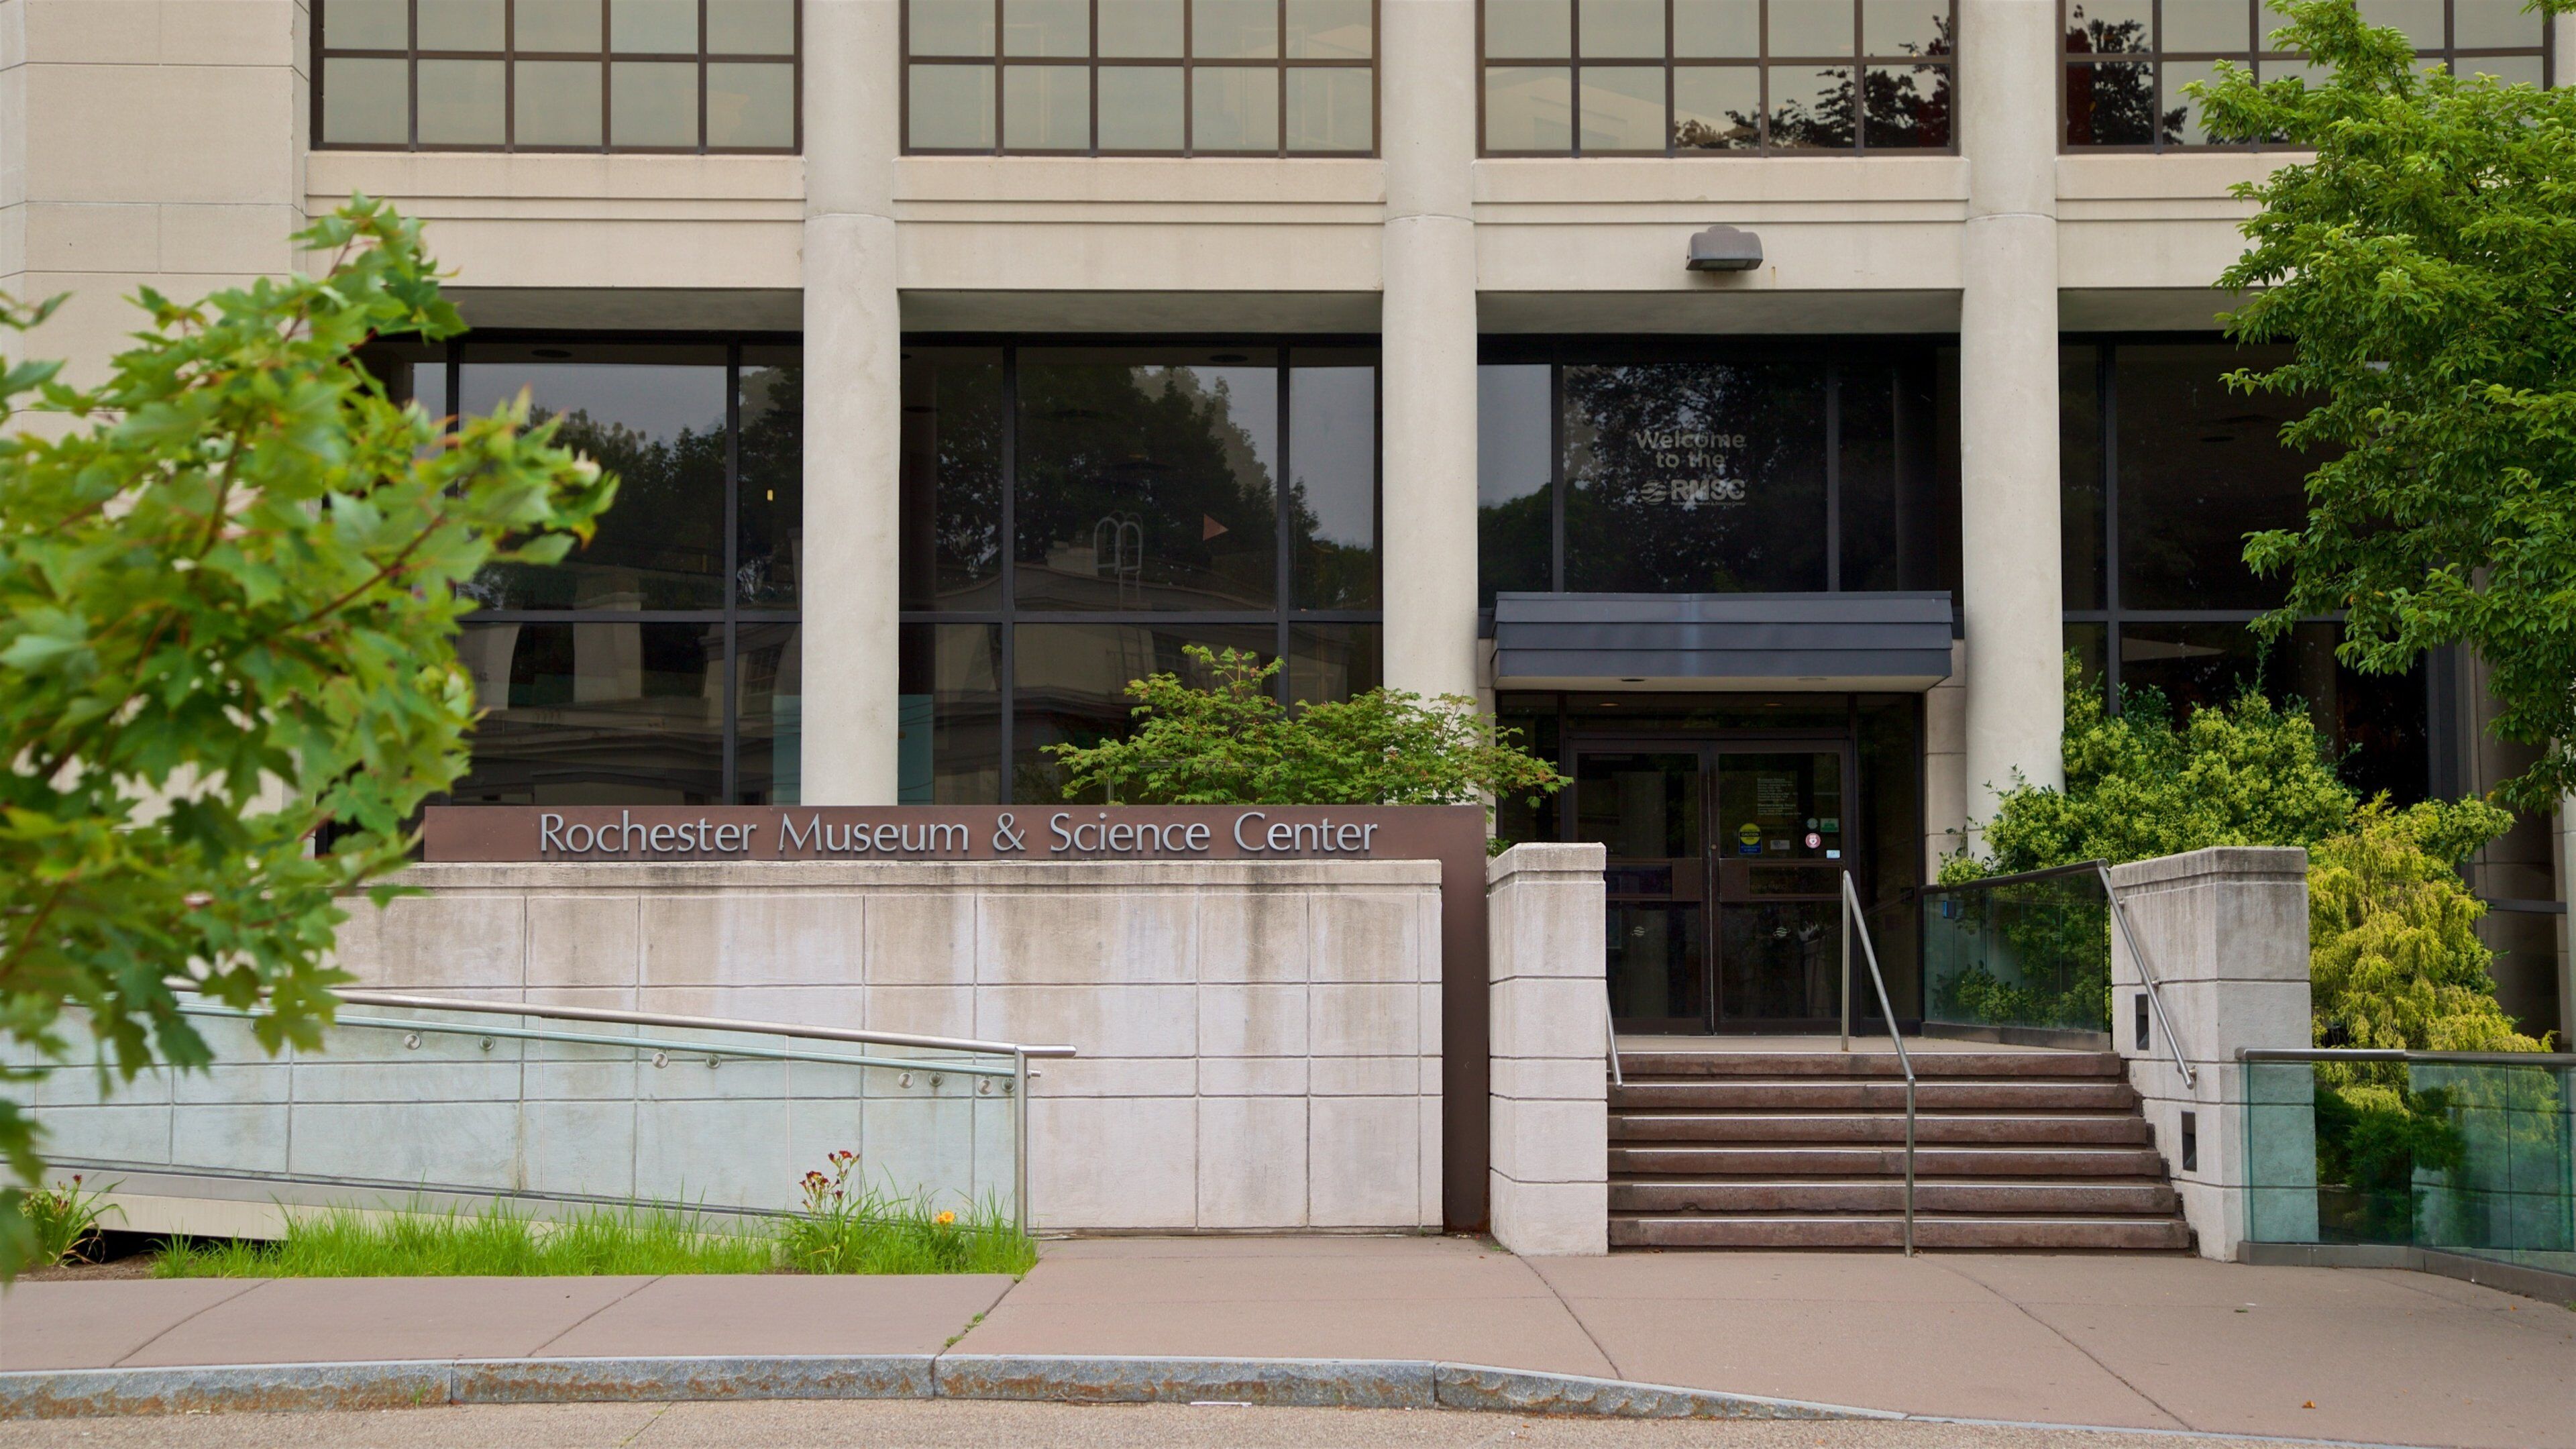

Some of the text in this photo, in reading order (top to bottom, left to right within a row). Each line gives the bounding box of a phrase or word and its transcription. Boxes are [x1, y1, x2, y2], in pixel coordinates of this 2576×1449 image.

[1635, 430, 1746, 449] Welcome
[1655, 449, 1726, 468] to the
[1670, 478, 1746, 500] RMSC
[540, 810, 1379, 852] Rochester Museum & Science Center
